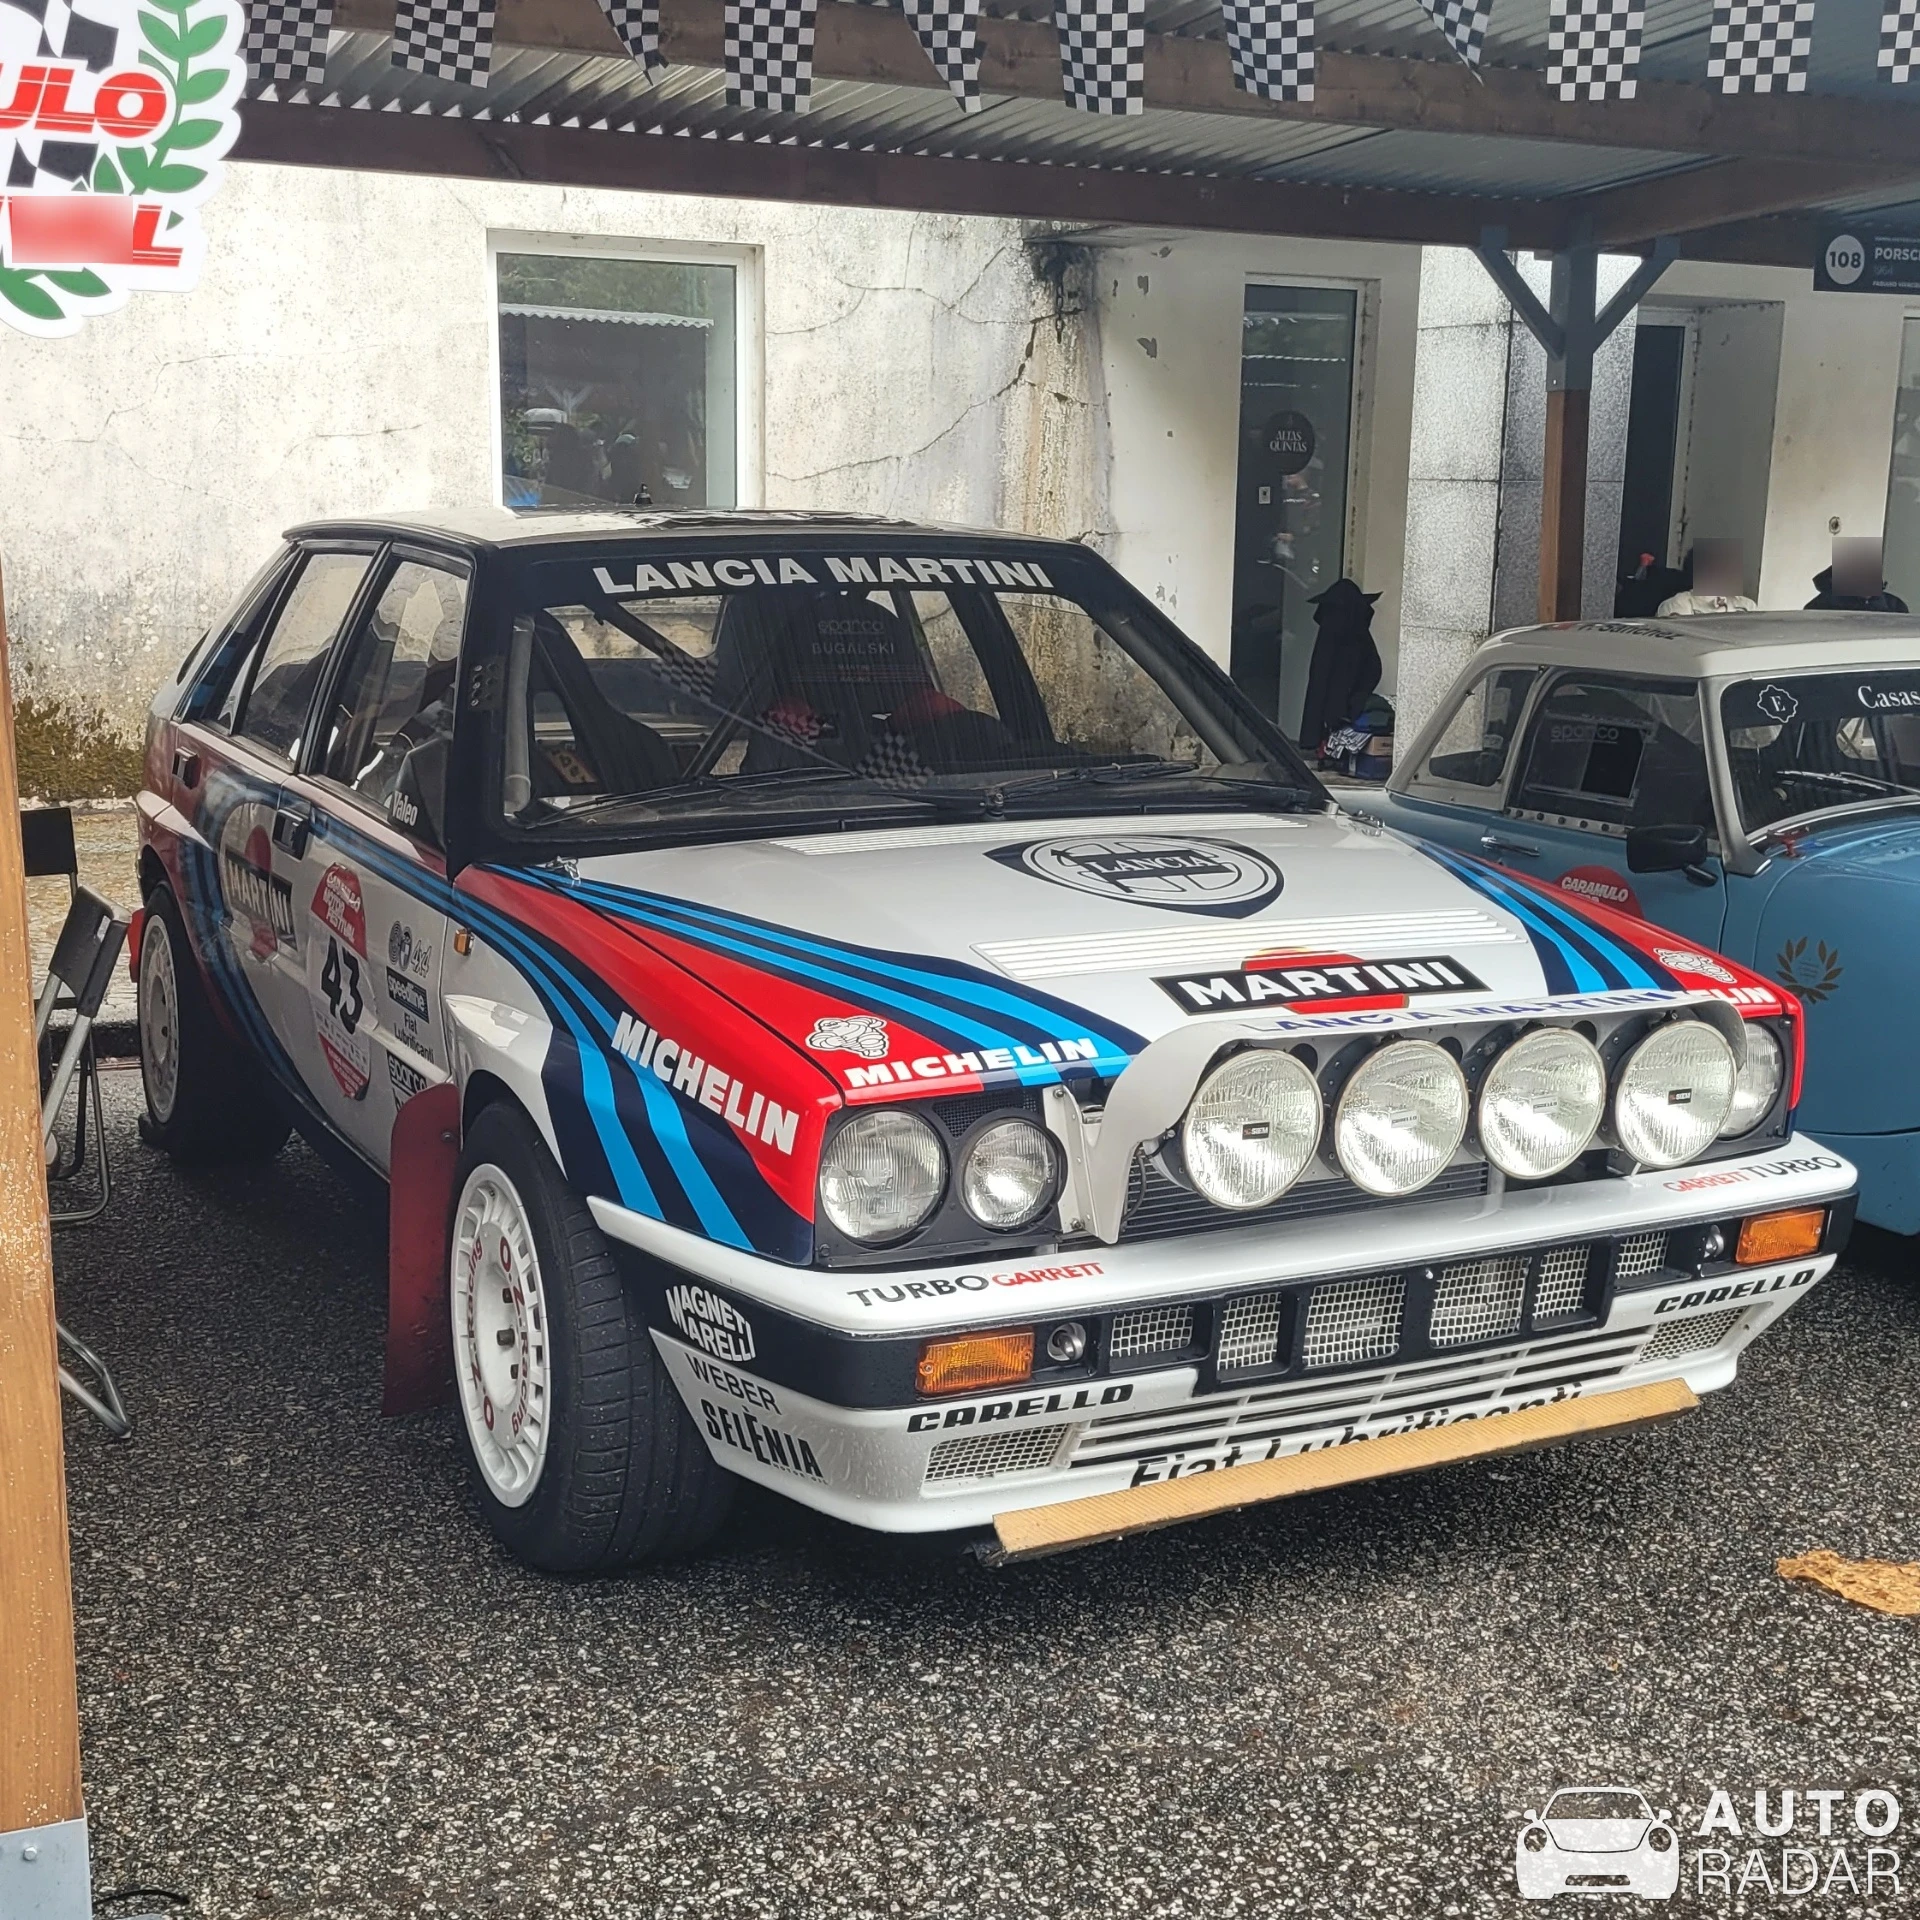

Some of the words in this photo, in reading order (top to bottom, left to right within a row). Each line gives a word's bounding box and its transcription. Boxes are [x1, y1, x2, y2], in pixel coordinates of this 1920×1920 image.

[1829, 251, 1861, 269] 108
[1874, 247, 1920, 261] PORSC
[1269, 440, 1308, 453] QUINTAS
[1276, 430, 1303, 441] ALTAS
[592, 557, 819, 594] LANCIA
[823, 557, 1054, 588] MARTINI
[812, 641, 895, 655] BUGALSKI
[392, 790, 418, 826] Valeo
[1084, 855, 1219, 874] LANCIA
[224, 857, 292, 936] MARTINI
[1561, 876, 1629, 903] CARAMULO
[321, 935, 363, 1035] 43
[1177, 961, 1464, 1006] MARTINI
[404, 1011, 418, 1035] Fiat
[1241, 1010, 1452, 1032] LANCIA
[1454, 991, 1677, 1016] MARTINI
[843, 1038, 1099, 1088] MICHELIN
[611, 1011, 799, 1156] MICHELIN
[1663, 1171, 1751, 1192] GARRETT
[1738, 1156, 1842, 1178] TURBO
[847, 1275, 989, 1307] TURBO
[992, 1262, 1105, 1287] GARRETT
[1654, 1268, 1816, 1315] CARELLO
[685, 1352, 782, 1415] WEBER
[907, 1384, 1134, 1433] CARELLO
